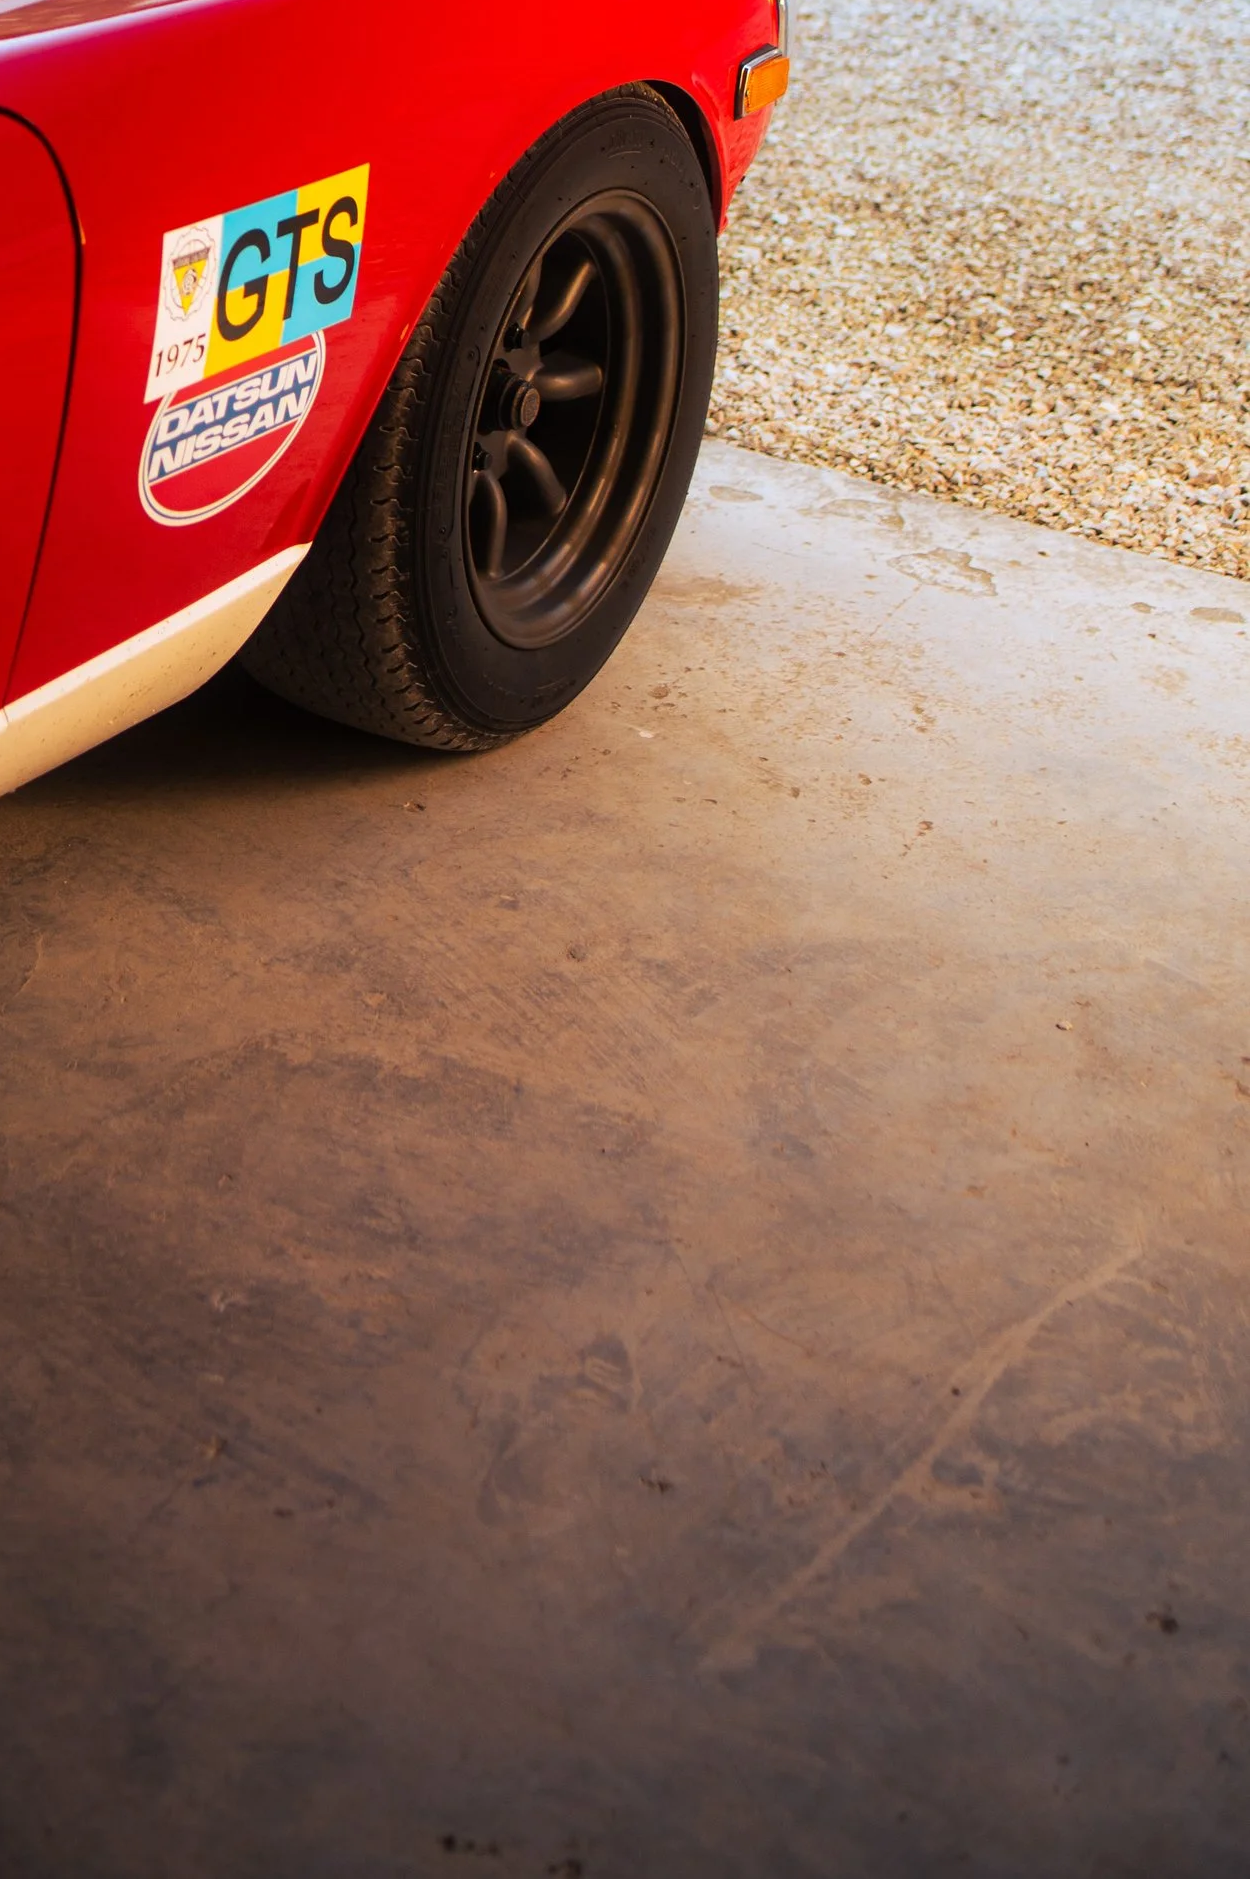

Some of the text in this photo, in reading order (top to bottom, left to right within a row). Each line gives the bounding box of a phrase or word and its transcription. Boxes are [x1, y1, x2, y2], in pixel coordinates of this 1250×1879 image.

[216, 196, 359, 342] GTS
[155, 333, 206, 378] 1975
[155, 351, 319, 446] DATSUN
[149, 384, 313, 482] NISSAN
